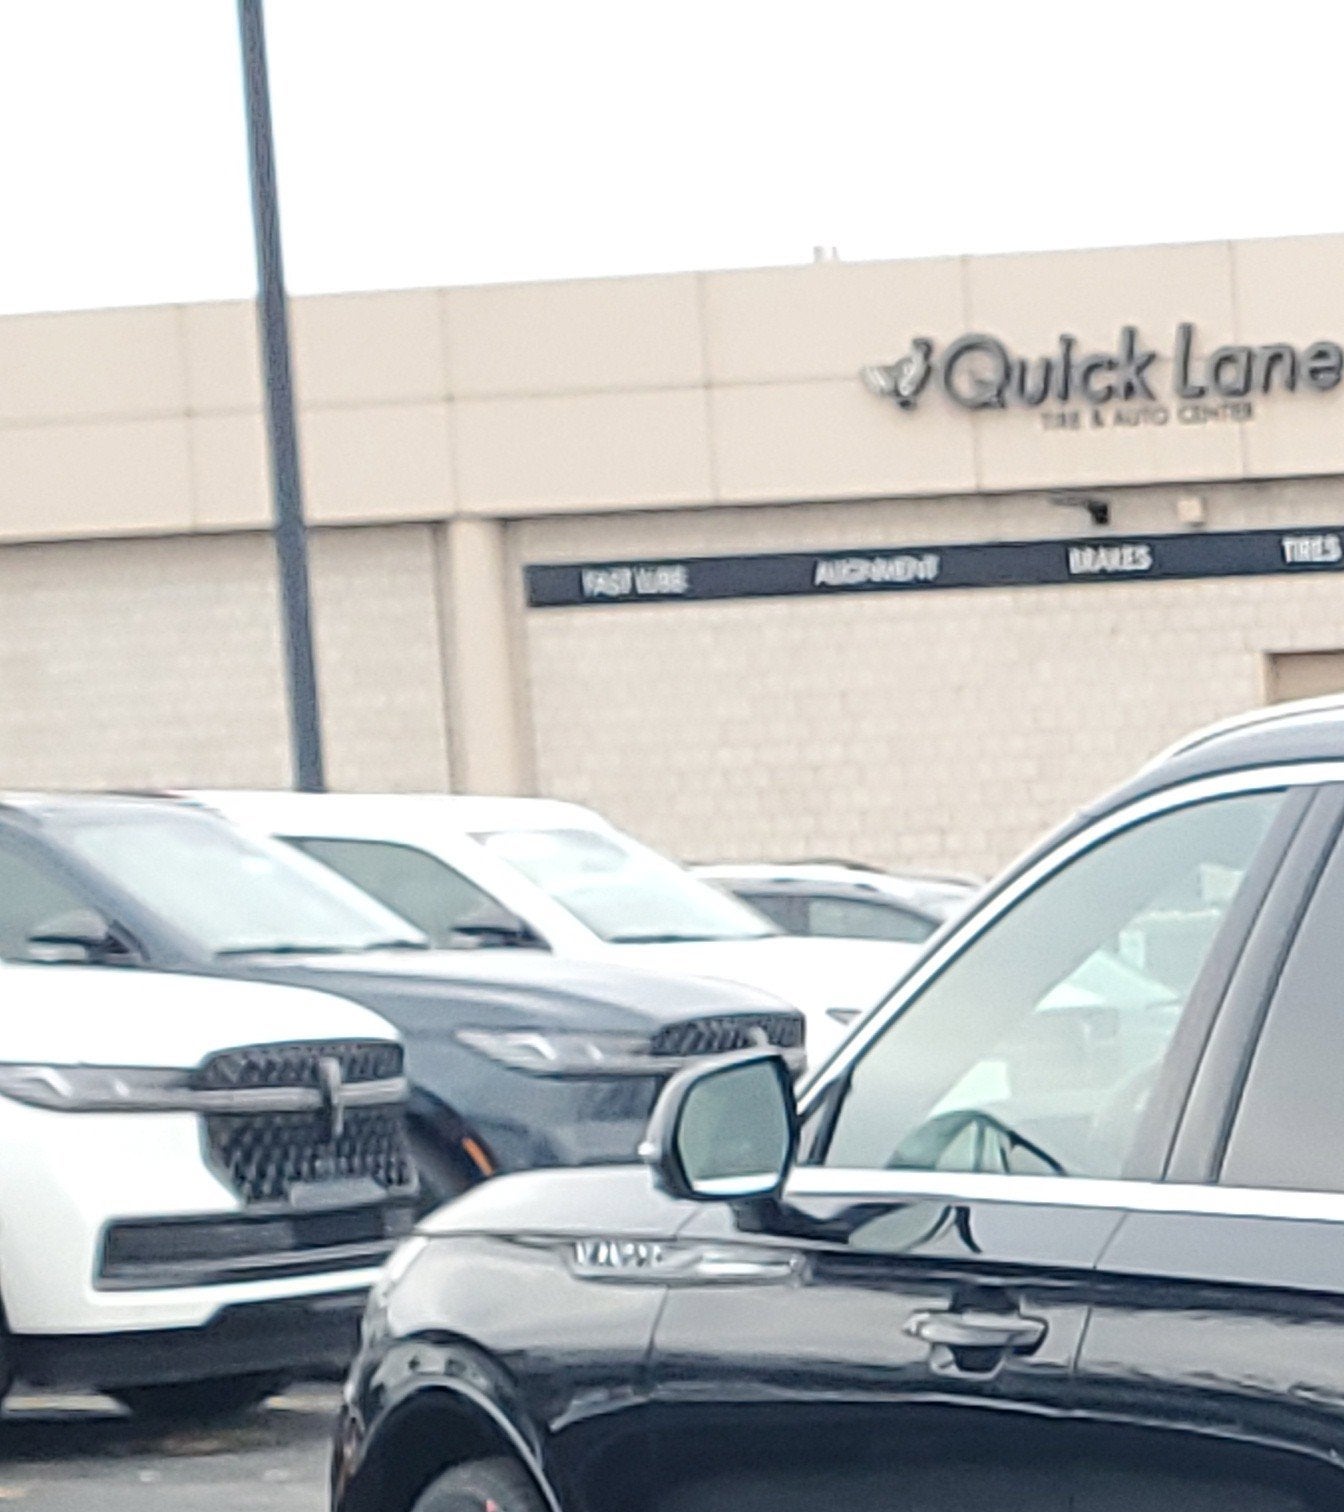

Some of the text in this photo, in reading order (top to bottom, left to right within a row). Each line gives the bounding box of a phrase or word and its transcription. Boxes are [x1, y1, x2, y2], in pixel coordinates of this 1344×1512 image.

[943, 324, 1158, 411] Quick
[1113, 405, 1169, 427] AUTO
[1177, 401, 1253, 425] CENTER
[1282, 534, 1343, 563] TIRES
